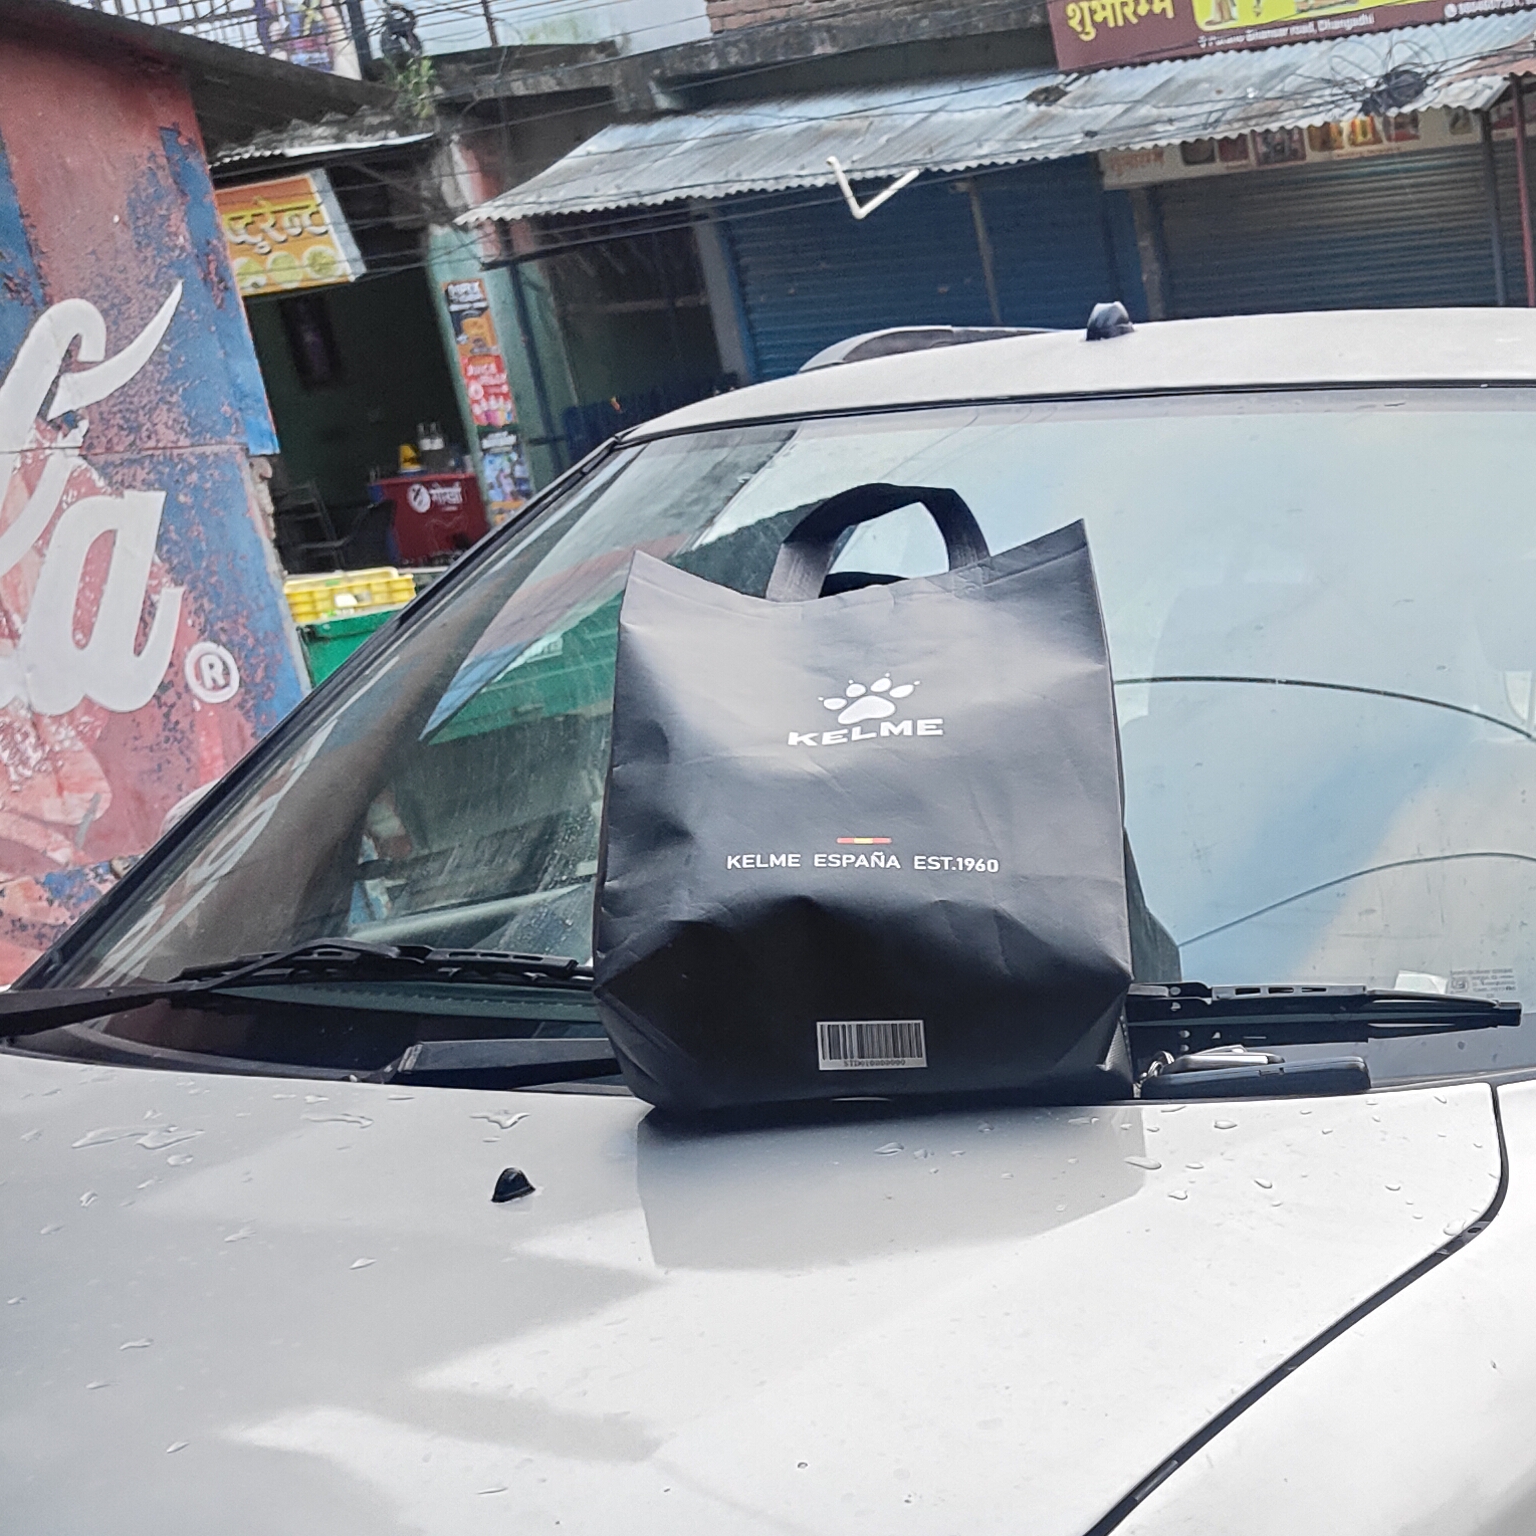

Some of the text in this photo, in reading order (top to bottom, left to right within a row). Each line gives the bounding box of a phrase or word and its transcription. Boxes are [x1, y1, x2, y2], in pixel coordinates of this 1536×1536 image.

[787, 718, 944, 746] KELME
[726, 851, 999, 873] KELME ESPAÑA EST.1960
